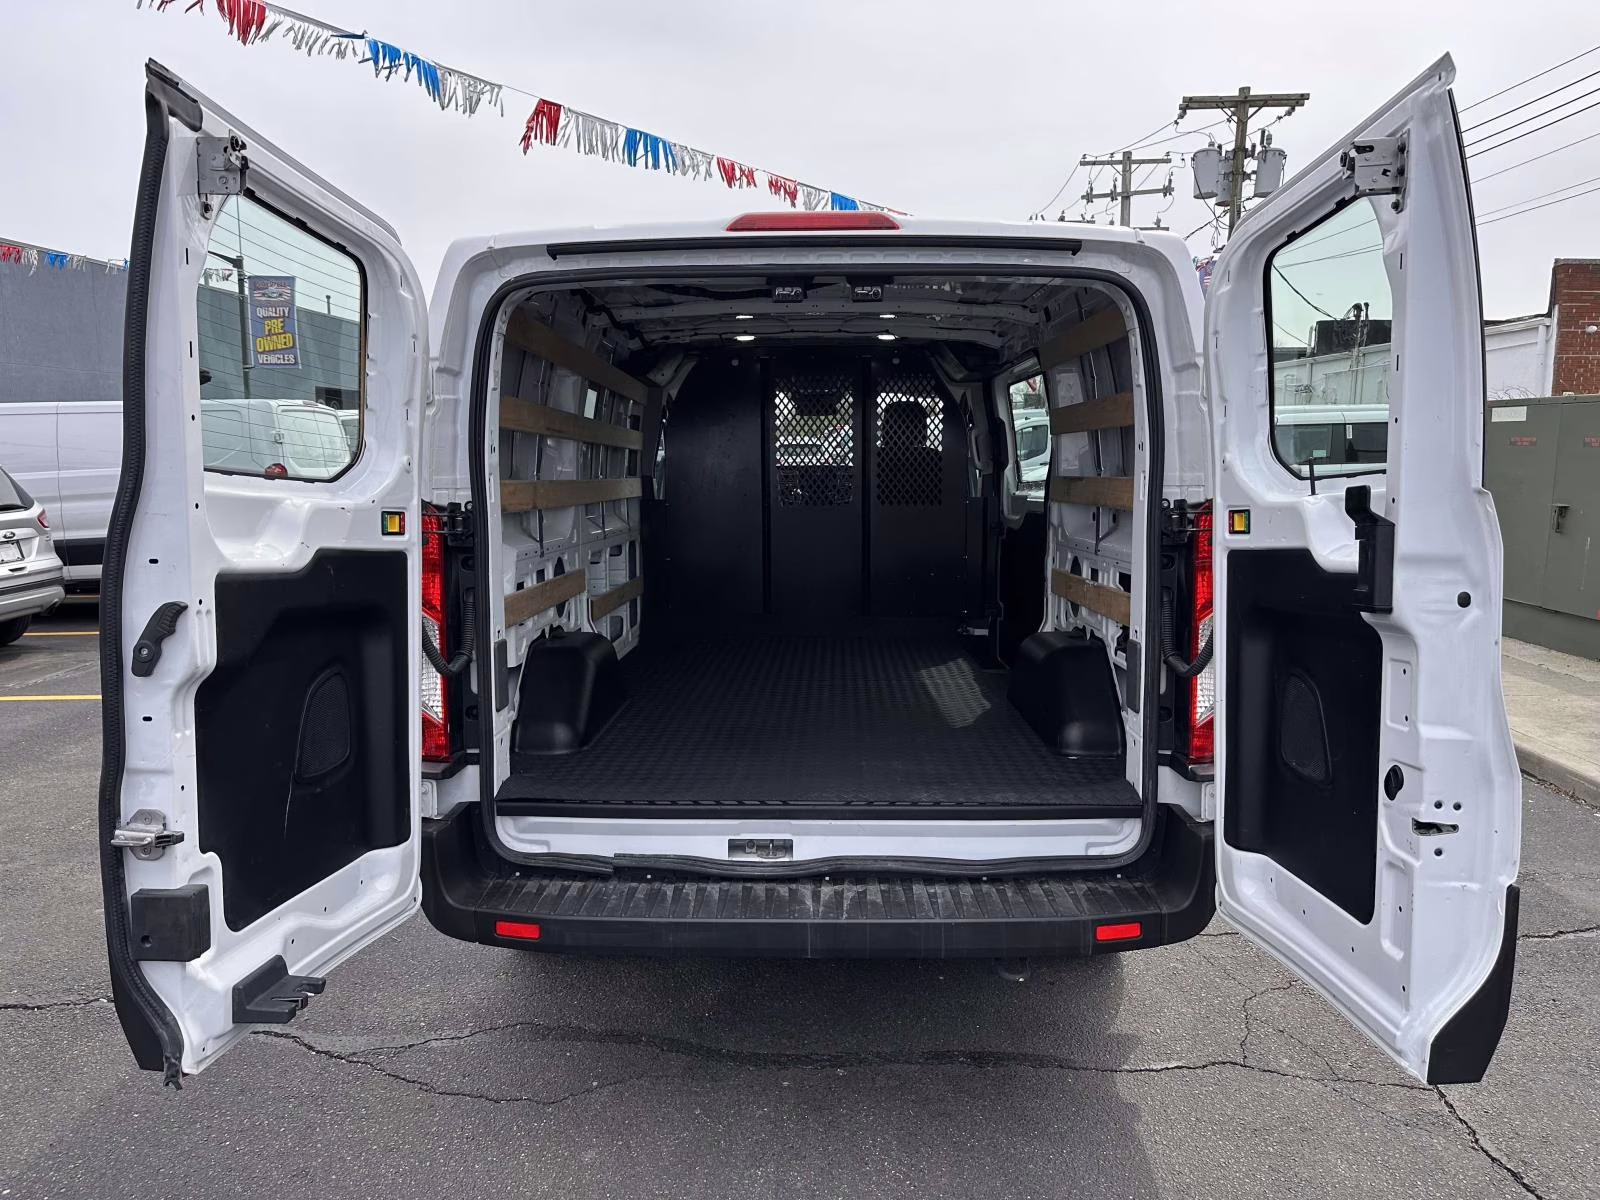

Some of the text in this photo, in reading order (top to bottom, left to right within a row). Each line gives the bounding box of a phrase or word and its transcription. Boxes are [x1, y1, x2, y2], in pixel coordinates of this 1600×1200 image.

[256, 306, 290, 318] QUALITY
[264, 318, 285, 335] PRE
[256, 333, 293, 352] OWNED
[257, 354, 296, 364] VEHICLES
